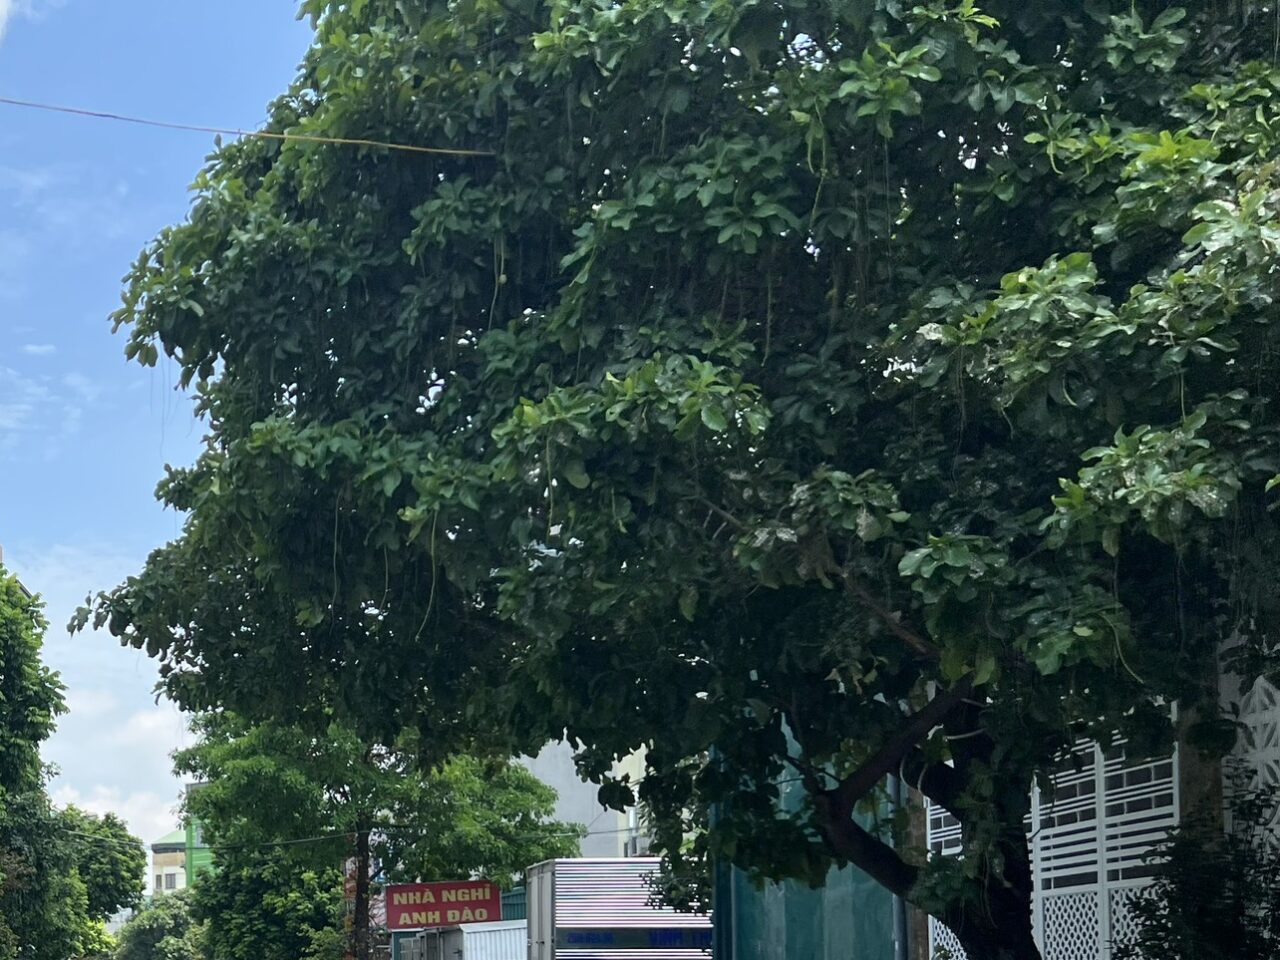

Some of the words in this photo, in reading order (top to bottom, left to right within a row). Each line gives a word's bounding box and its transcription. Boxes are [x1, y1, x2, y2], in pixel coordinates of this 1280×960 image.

[393, 888, 435, 905] NHÀ
[398, 910, 440, 925] ANH
[446, 906, 488, 923] ĐÀO
